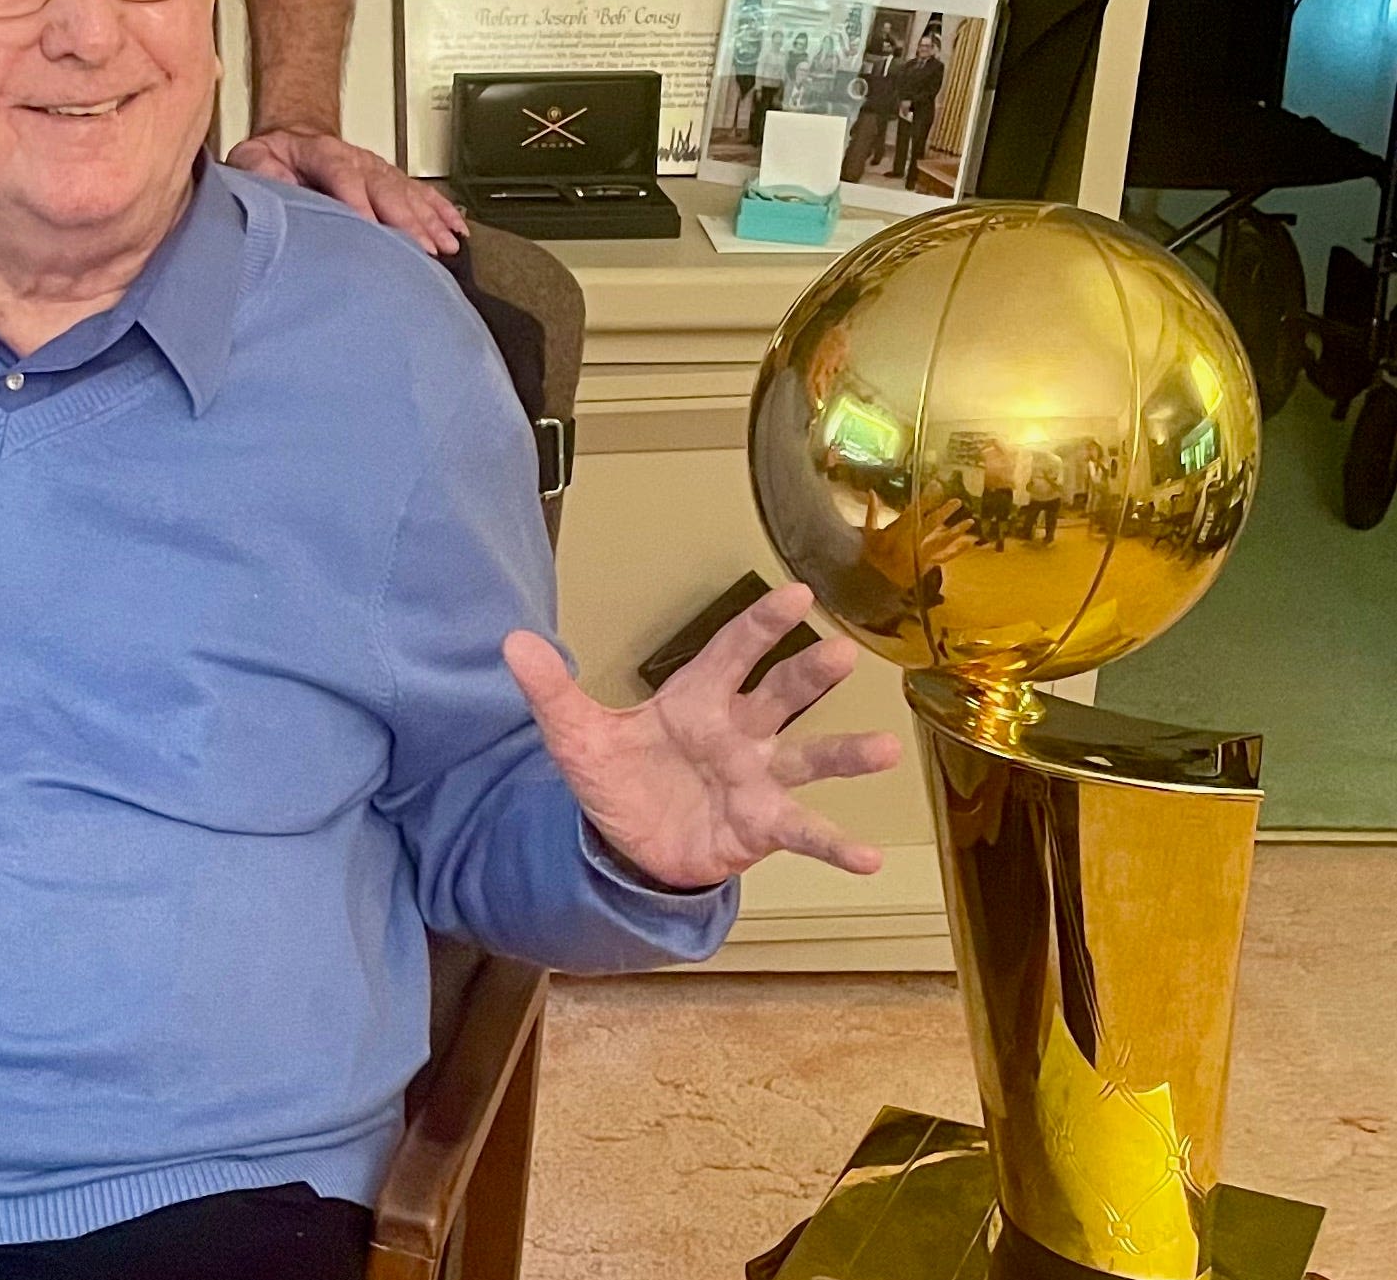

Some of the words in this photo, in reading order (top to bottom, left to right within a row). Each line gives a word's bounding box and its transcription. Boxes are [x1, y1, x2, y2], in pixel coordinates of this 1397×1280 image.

[475, 7, 528, 26] Robert
[535, 7, 588, 27] Joseph
[633, 5, 683, 30] Cousy
